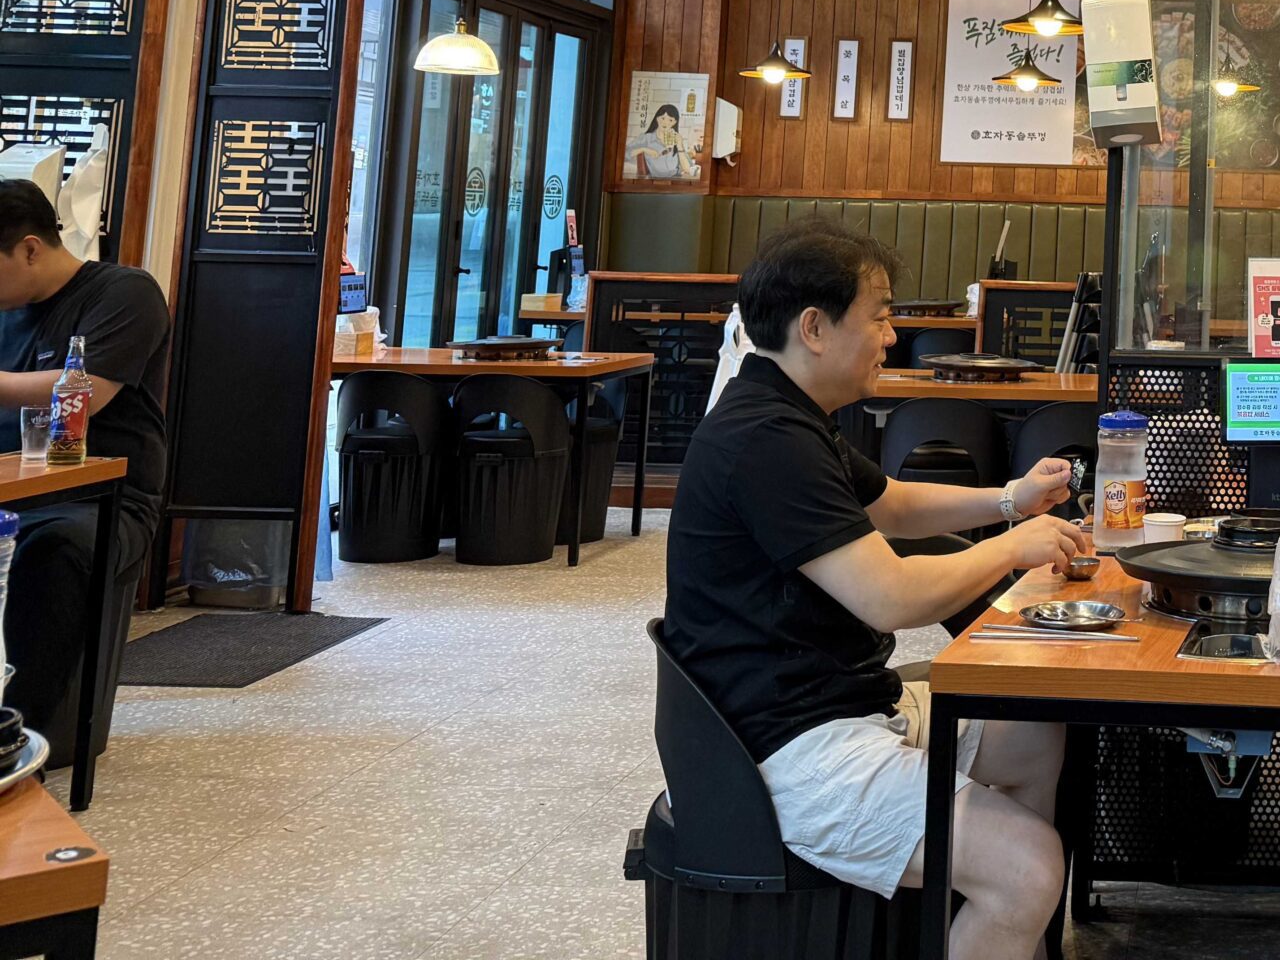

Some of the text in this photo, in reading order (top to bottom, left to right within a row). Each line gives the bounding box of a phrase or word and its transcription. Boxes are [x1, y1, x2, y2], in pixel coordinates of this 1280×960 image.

[982, 129, 1047, 142] 효자동솥뚜껑
[1105, 490, 1126, 502] Kelly
[1272, 493, 1280, 501] kt
